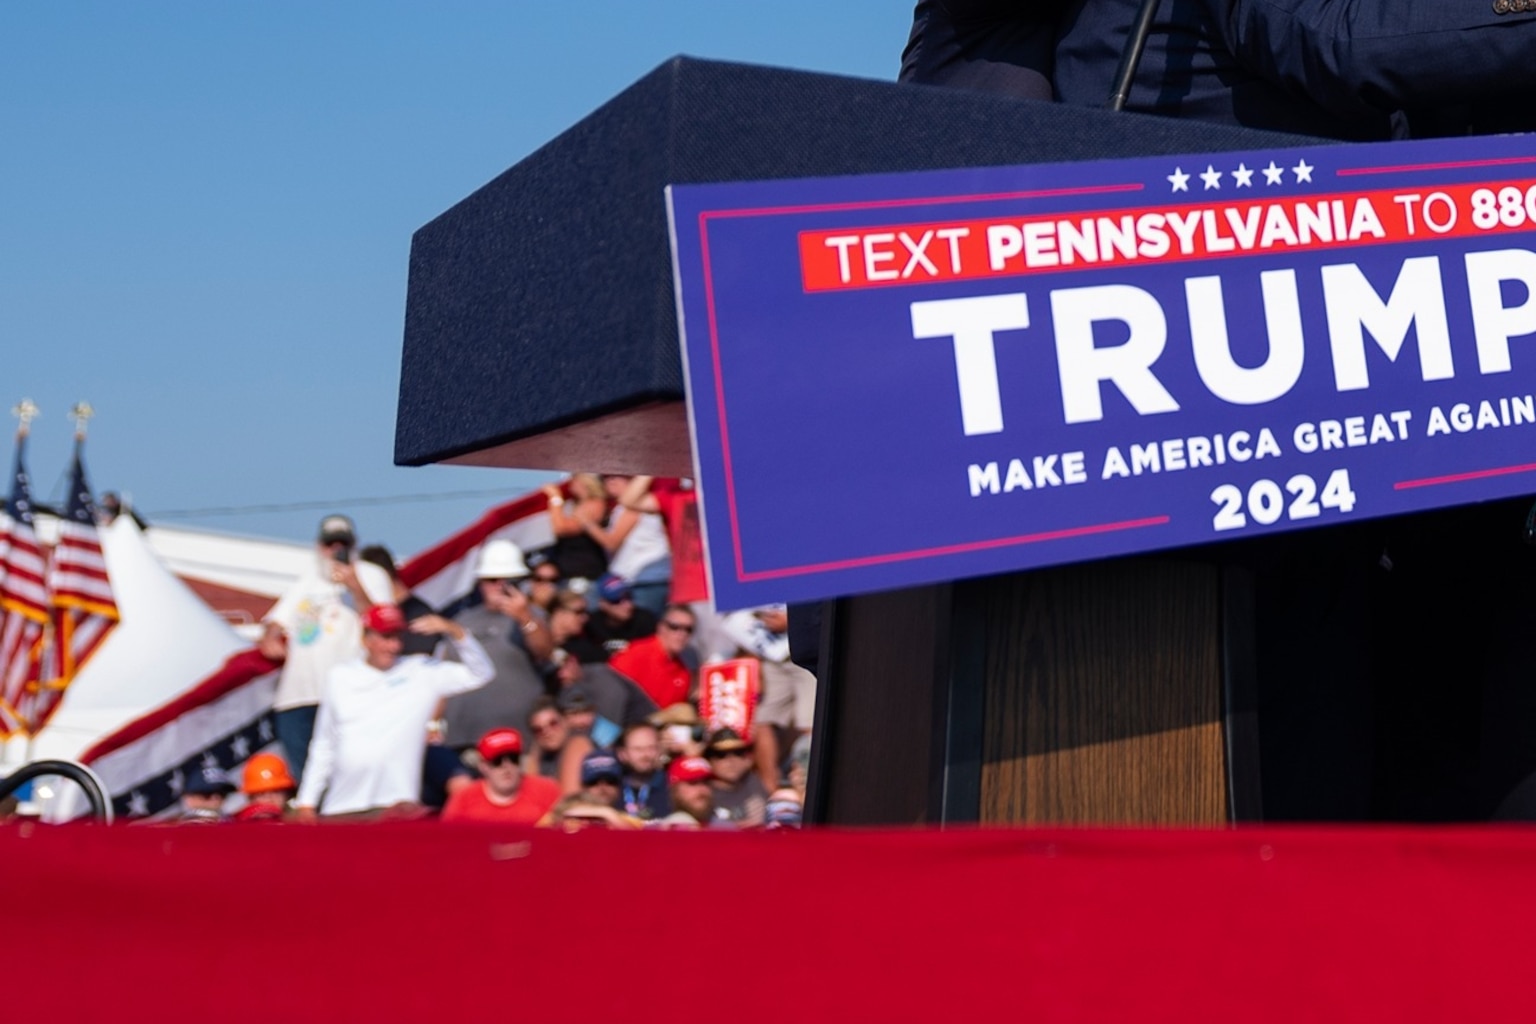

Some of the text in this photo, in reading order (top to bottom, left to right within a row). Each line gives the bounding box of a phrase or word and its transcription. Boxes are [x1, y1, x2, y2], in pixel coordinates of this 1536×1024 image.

[825, 227, 971, 283] TEXT
[987, 198, 1386, 270] PENNSYLVANIA
[1393, 192, 1458, 235] TO
[966, 451, 1088, 498] MAKE
[1100, 427, 1282, 480] AMERICA
[1292, 410, 1413, 454] GREAT
[1209, 467, 1357, 532] 2024
